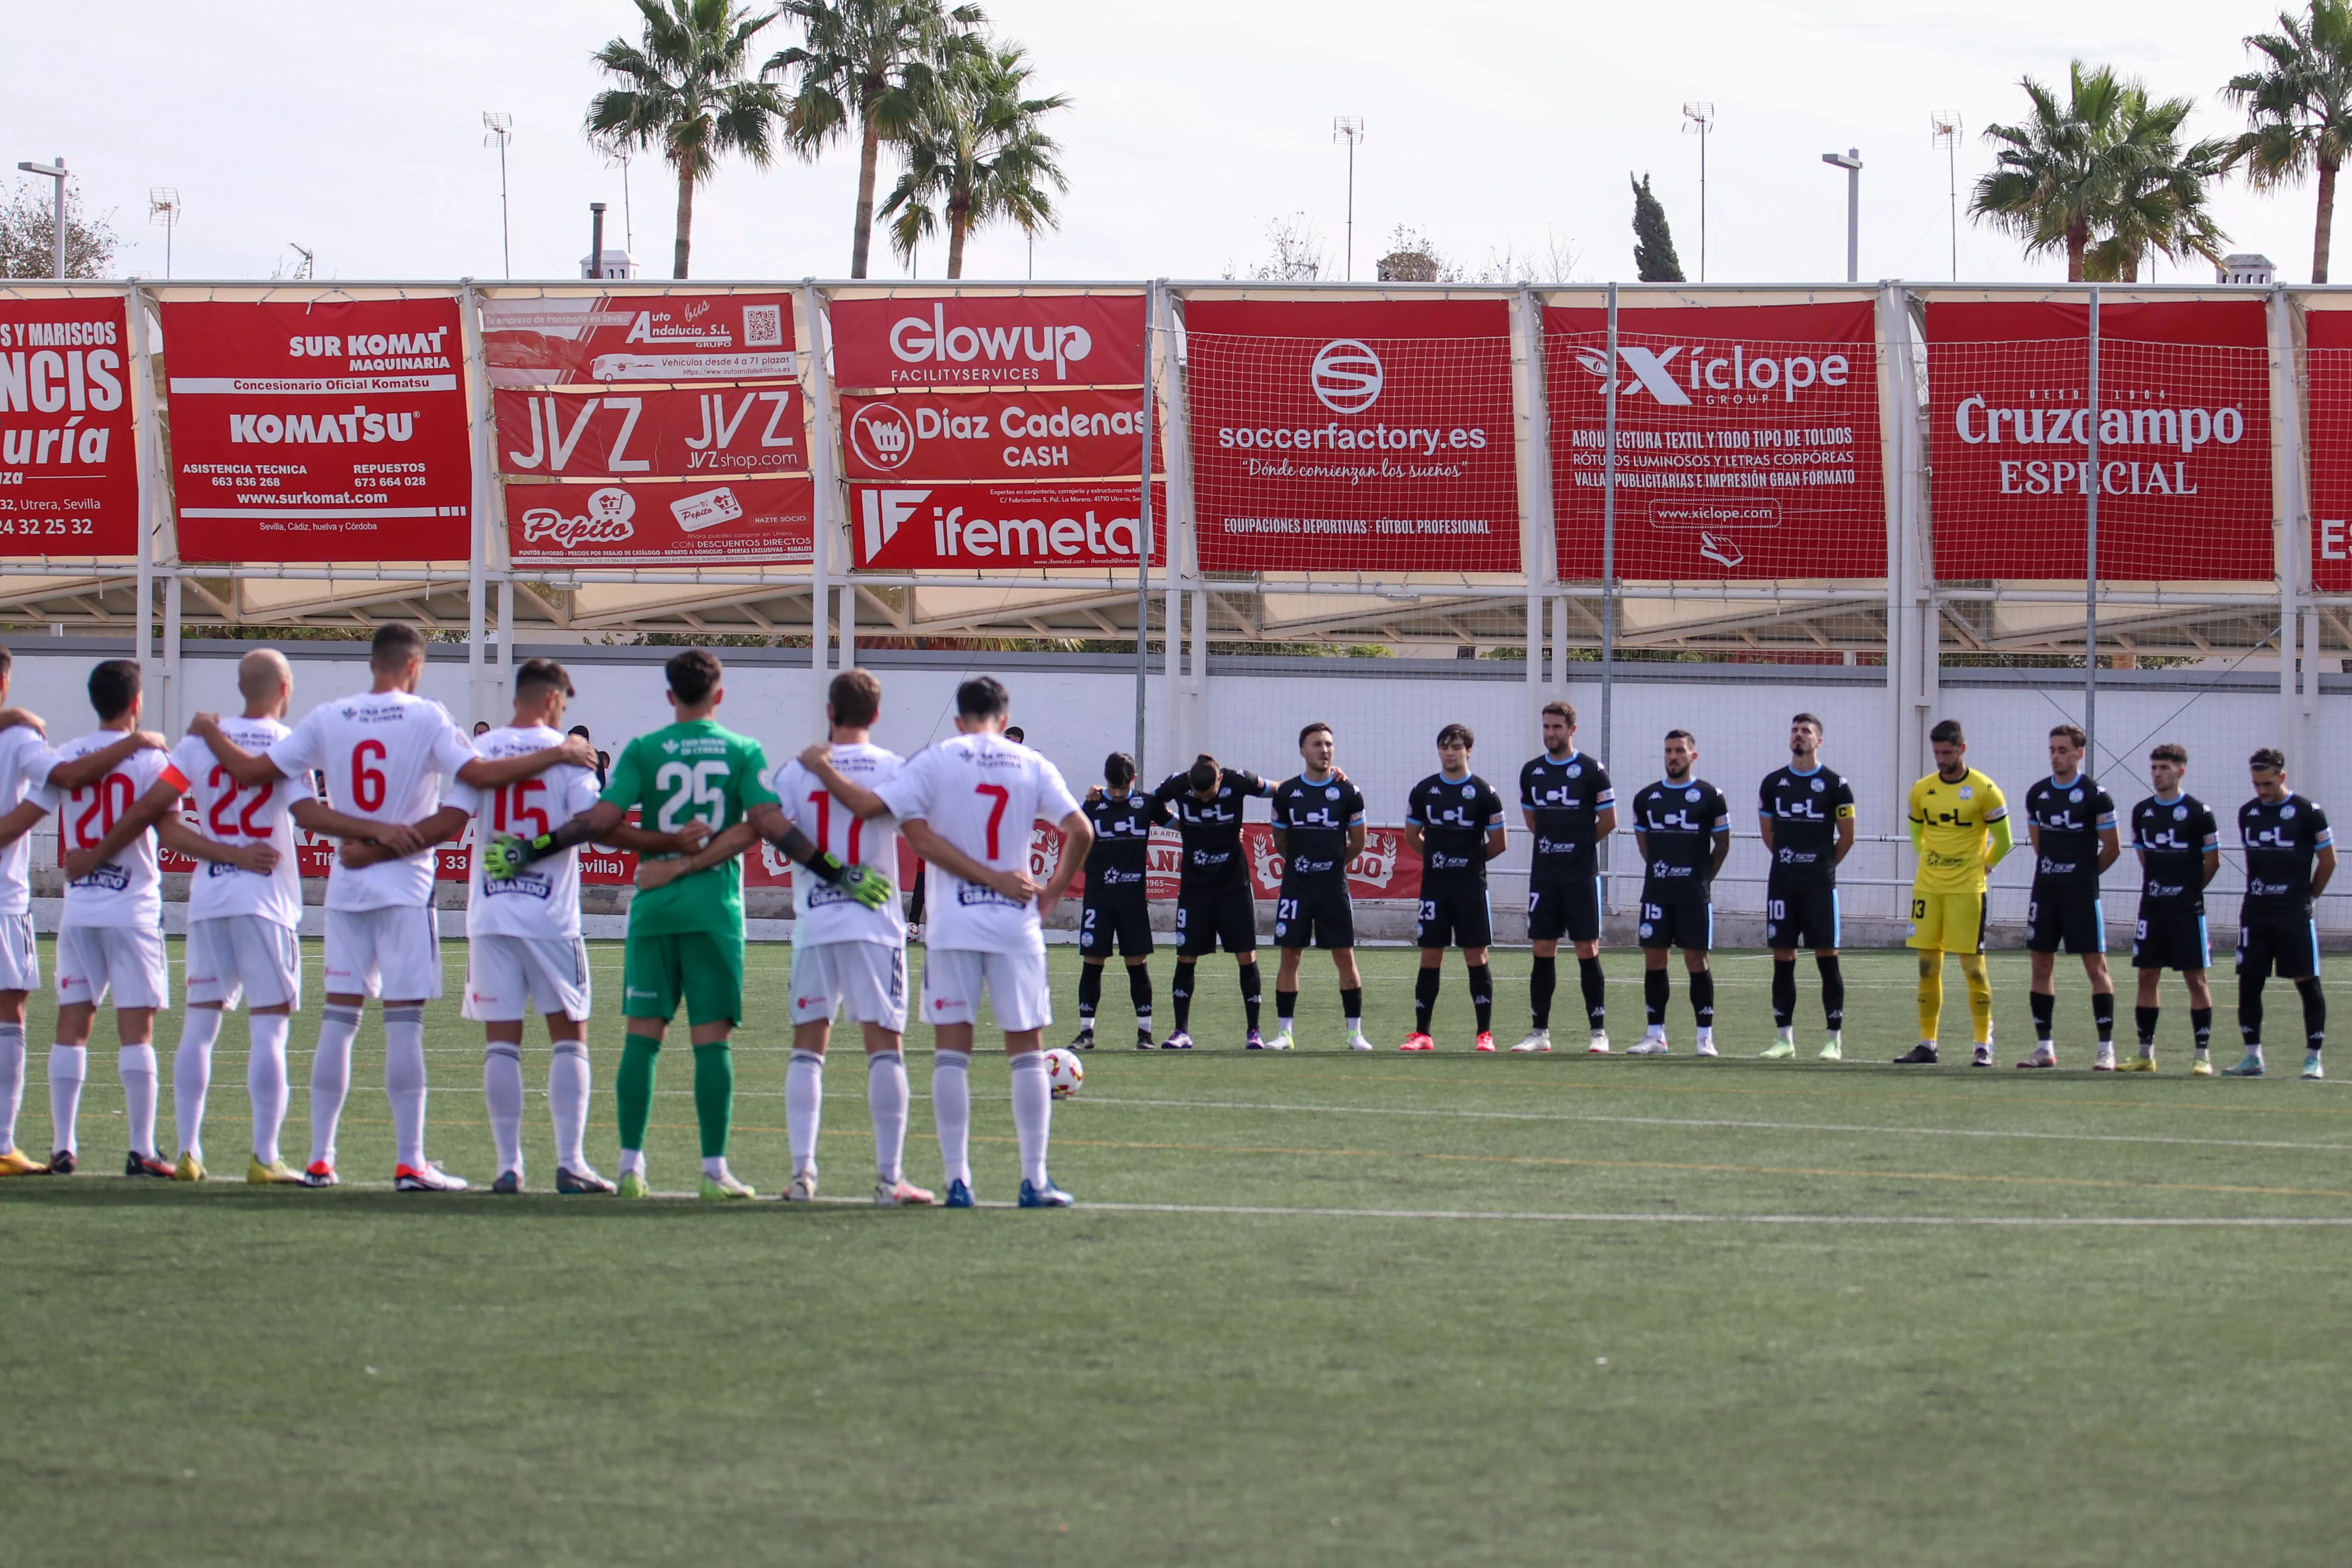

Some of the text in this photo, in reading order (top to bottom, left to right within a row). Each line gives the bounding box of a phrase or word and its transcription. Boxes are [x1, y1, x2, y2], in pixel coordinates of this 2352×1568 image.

[547, 315, 587, 324] transporte
[684, 300, 710, 322] bus
[14, 321, 116, 346] Y MARISCOS
[709, 324, 730, 335] S.L.
[289, 326, 447, 357] SUR KOMAT
[890, 302, 1092, 380] Glowup
[349, 356, 451, 371] MAQUINARIA
[662, 358, 702, 366] Vehículos
[762, 357, 790, 366] plazas
[0, 348, 122, 413] NCIS
[234, 378, 429, 390] Concesionario Oficial Komatsu
[891, 368, 1039, 381] FACILITYSERVICES
[1706, 394, 1769, 404] GROUP
[2029, 390, 2165, 399] DESD 1904
[684, 391, 793, 449] JVZ
[1000, 406, 1144, 439] Cadenas
[1955, 393, 2243, 453] Cruzcampo
[3, 416, 110, 465] uría
[509, 397, 650, 472] JVZ
[1219, 423, 1486, 456] soccerfactory.es
[1573, 427, 1852, 449] ARQUECTURA TEXTIL Y TODO TIPO DE TOLDOS
[1003, 445, 1069, 467] CASH
[1573, 449, 1854, 467] RÓTUOS LUMINOSOS Y LETRAS CORPÓREAS
[183, 464, 307, 474] ASISTENCIA TECNICA
[353, 463, 426, 473] REPUESTOS
[1299, 464, 1379, 485] comienzan
[1381, 458, 1405, 477] los
[1999, 460, 2198, 495] ESPECIAL
[212, 477, 280, 486] 663 636 268
[355, 477, 426, 487] 673 664 028
[1574, 469, 1855, 489] VALLA PUBLICITARIAS E IMPRESIÓN GRAN FORMATO
[20, 499, 61, 511] Utrera,
[63, 498, 101, 510] Sevilla
[237, 491, 388, 504] www.surkomat.com
[681, 508, 713, 521] Pepito
[1657, 507, 1772, 522] www.xiclope.com
[18, 518, 93, 534] 32 25 32
[260, 523, 286, 531] Sevilla,
[287, 523, 311, 531] Cádiz,
[313, 523, 337, 531] huelva
[345, 522, 377, 530] Córdoba
[527, 512, 630, 546] Pepito
[1224, 516, 1490, 535] EQUIPACIONES DEPORTIVAS FÚTBOL PROFESIONAL
[697, 539, 760, 548] DESCUENTOS
[763, 537, 811, 546] DIRECTOS
[352, 739, 386, 813] 6
[209, 764, 273, 837] 22
[656, 760, 730, 834] 25
[71, 772, 134, 849] 20
[494, 780, 548, 839] 15
[1839, 808, 1847, 817] C
[975, 783, 1008, 861] 7
[446, 856, 467, 869] 33
[1084, 908, 1096, 929] 2
[1177, 908, 1187, 928] 9
[1279, 899, 1298, 920] 21
[1419, 901, 1436, 920] 23
[1645, 903, 1662, 920] 15
[1768, 900, 1785, 920] 10
[1911, 900, 1925, 919] 13
